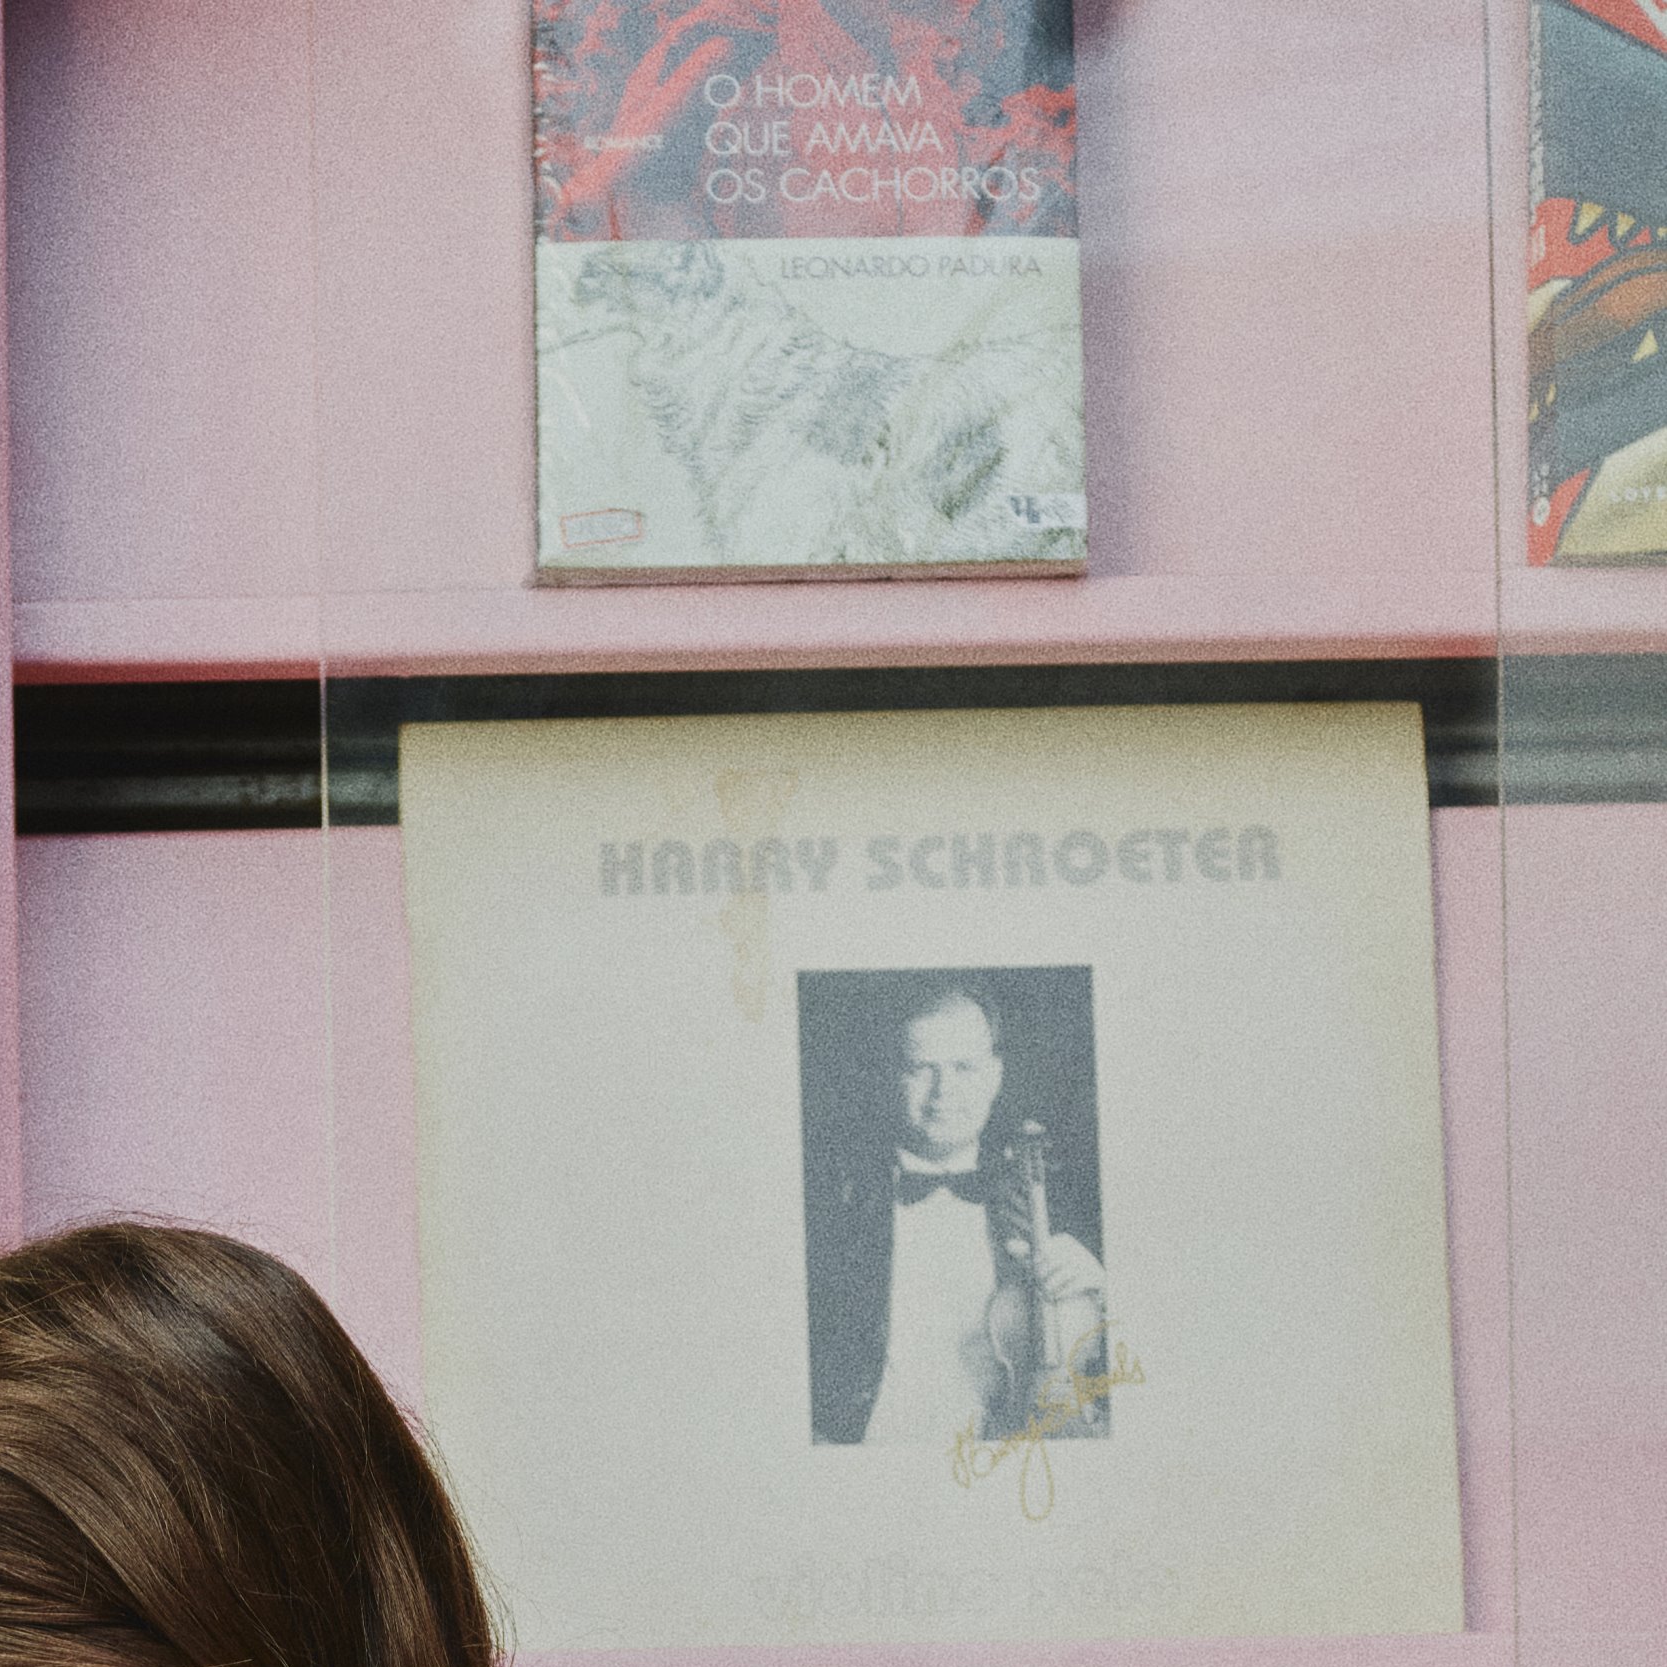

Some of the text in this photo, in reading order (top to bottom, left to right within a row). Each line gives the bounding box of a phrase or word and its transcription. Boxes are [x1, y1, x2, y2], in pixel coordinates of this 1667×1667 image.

[704, 73, 925, 111] O HOMEM
[705, 119, 945, 158] QUE AMAVA
[705, 166, 1041, 205] OS CACHORROS
[781, 253, 1044, 281] LEONARDO PADURA
[599, 823, 1283, 899] HARRY SCHROETER
